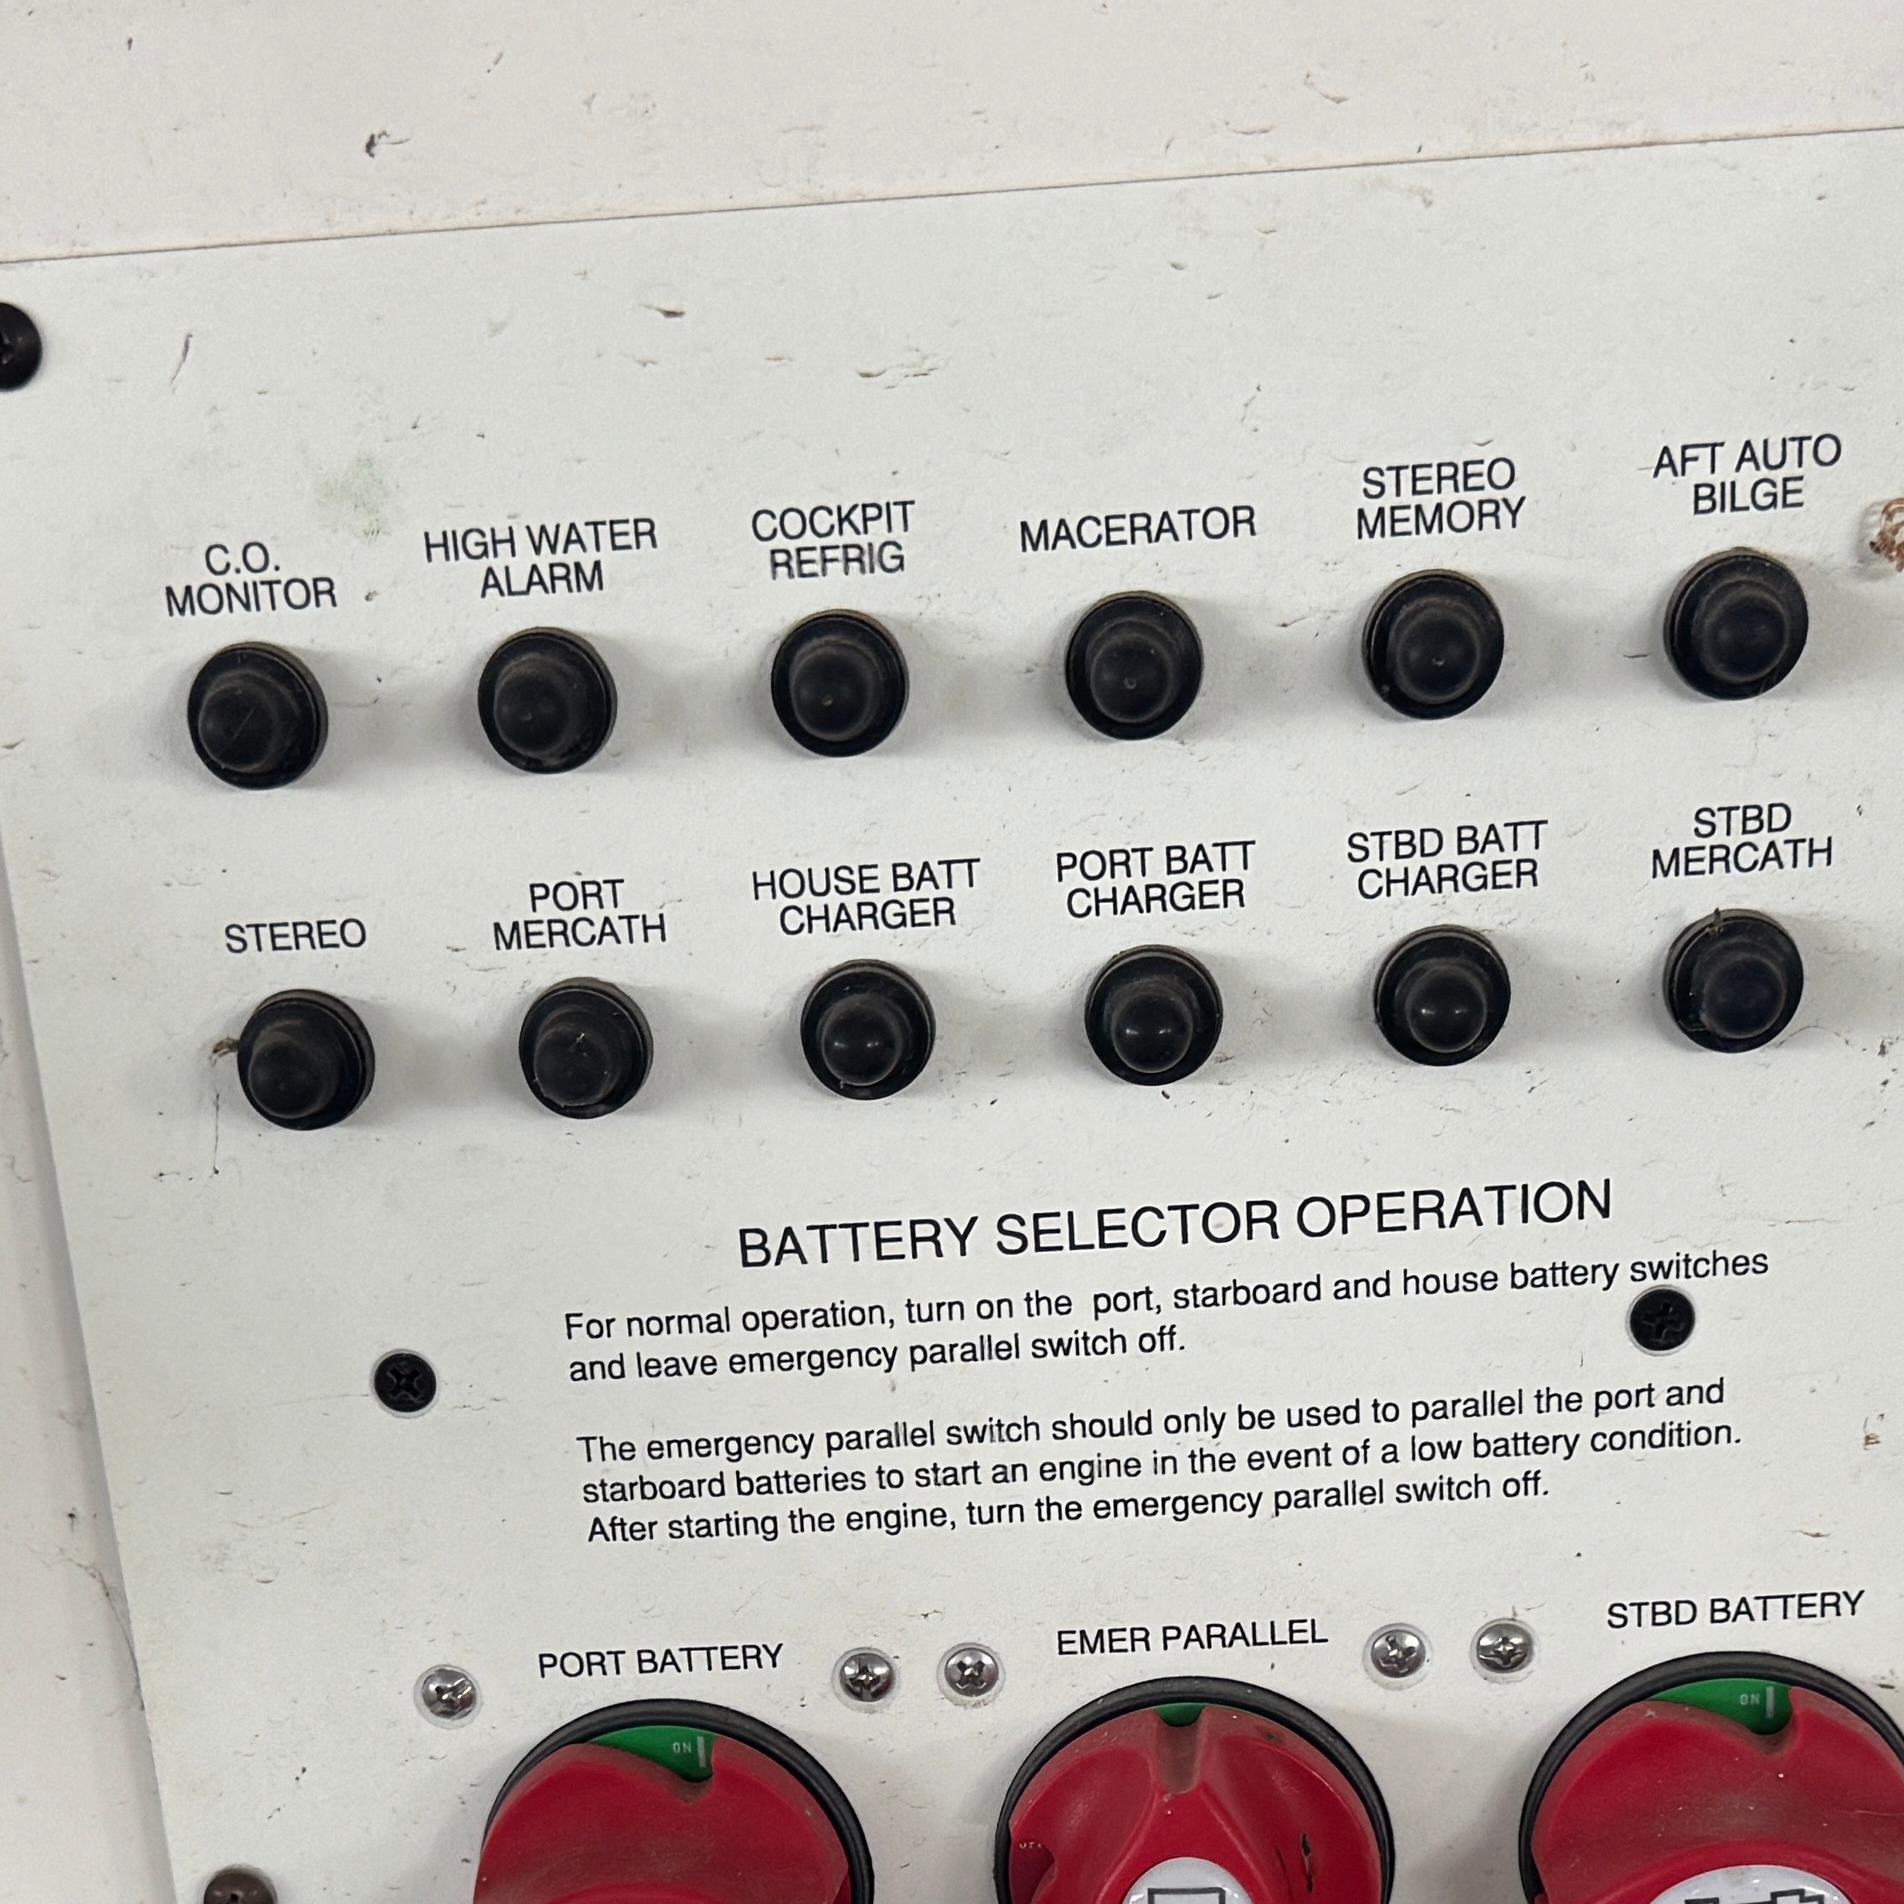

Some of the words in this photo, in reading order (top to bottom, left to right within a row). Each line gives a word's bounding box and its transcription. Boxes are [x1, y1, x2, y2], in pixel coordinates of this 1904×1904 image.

[1652, 440, 1724, 480] AFT
[1734, 432, 1842, 474] AUTO
[1362, 456, 1516, 500] STEREO
[1693, 474, 1805, 516] BILGE
[751, 499, 916, 543] COCKPIT
[1019, 504, 1257, 553] MACERATOR
[1356, 495, 1527, 541] MEMORY
[204, 540, 281, 577] C.O.
[423, 525, 517, 564] HIGH
[524, 517, 658, 557] WATER
[769, 539, 905, 581] REFRIG
[164, 576, 338, 618] MONITOR
[480, 559, 604, 599] ALARM
[1347, 827, 1444, 864] STBD
[1456, 819, 1549, 856] BATT
[1693, 802, 1792, 839] STBD
[751, 863, 881, 901] HOUSE
[891, 857, 982, 893] BATT
[1056, 846, 1155, 883] PORT
[1165, 839, 1257, 876] BATT
[1357, 857, 1539, 900] CHARGER
[1651, 835, 1833, 880] MERCATH
[528, 878, 625, 914] PORT
[779, 896, 957, 936] CHARGER
[1066, 877, 1246, 919] CHARGER
[224, 917, 367, 954] STEREO
[492, 912, 667, 952] MERCATH
[738, 1215, 979, 1269] BATTERY
[996, 1199, 1280, 1256] SELECTOR
[1296, 1177, 1611, 1238] OPERATION
[564, 1312, 617, 1341] For
[626, 1305, 731, 1338] normal
[741, 1299, 895, 1339] operation,
[904, 1297, 965, 1324] turn
[975, 1297, 1014, 1321] on
[1023, 1288, 1073, 1318] the
[1092, 1285, 1162, 1322] port,
[1173, 1273, 1322, 1310] starboard
[1332, 1269, 1391, 1301] and
[1402, 1267, 1499, 1296] house
[1510, 1260, 1621, 1292] battery
[1629, 1248, 1769, 1283] switches
[569, 1351, 627, 1382] and
[635, 1351, 718, 1379] leave
[728, 1345, 899, 1378] emergency
[908, 1331, 1020, 1373] parallel
[1031, 1327, 1128, 1360] switch
[1137, 1323, 1186, 1354] off.
[575, 1435, 637, 1463] The
[646, 1432, 815, 1464] emergency
[825, 1419, 936, 1459] parallel
[945, 1414, 1041, 1446] switch
[1051, 1408, 1153, 1441] should
[1163, 1405, 1227, 1440] only
[1237, 1403, 1276, 1431] be
[1286, 1397, 1361, 1429] used
[1370, 1397, 1400, 1424] to
[1411, 1387, 1524, 1429] parallel
[1533, 1386, 1584, 1415] the
[1594, 1382, 1656, 1419] port
[1665, 1376, 1725, 1407] and
[582, 1470, 726, 1504] starboard
[734, 1465, 867, 1497] batteries
[875, 1464, 905, 1490] to
[914, 1459, 983, 1488] start
[991, 1462, 1028, 1485] an
[1039, 1452, 1142, 1487] engine
[1152, 1448, 1178, 1476] in
[1187, 1446, 1237, 1475] the
[1246, 1441, 1333, 1472] event
[1341, 1437, 1371, 1466] of
[1380, 1442, 1401, 1465] a
[1410, 1434, 1463, 1462] low
[1472, 1431, 1581, 1462] battery
[1590, 1419, 1742, 1453] condition.
[587, 1515, 659, 1543] After
[667, 1510, 779, 1542] starting
[787, 1506, 836, 1534] the
[845, 1501, 957, 1537] engine,
[965, 1500, 1025, 1526] turn
[1034, 1495, 1083, 1523] the
[1092, 1490, 1264, 1523] emergency
[1273, 1477, 1384, 1518] parallel
[1395, 1472, 1491, 1504] switch
[1502, 1468, 1549, 1498] off.
[1606, 1599, 1698, 1630] STBD
[1709, 1589, 1866, 1625] BATTERY
[1056, 1626, 1151, 1656] EMER
[1161, 1617, 1329, 1652] PARALLEL
[538, 1649, 627, 1679] PORT
[636, 1642, 784, 1675] BATTERY
[1738, 1693, 1761, 1706] ON
[672, 1741, 693, 1753] ON
